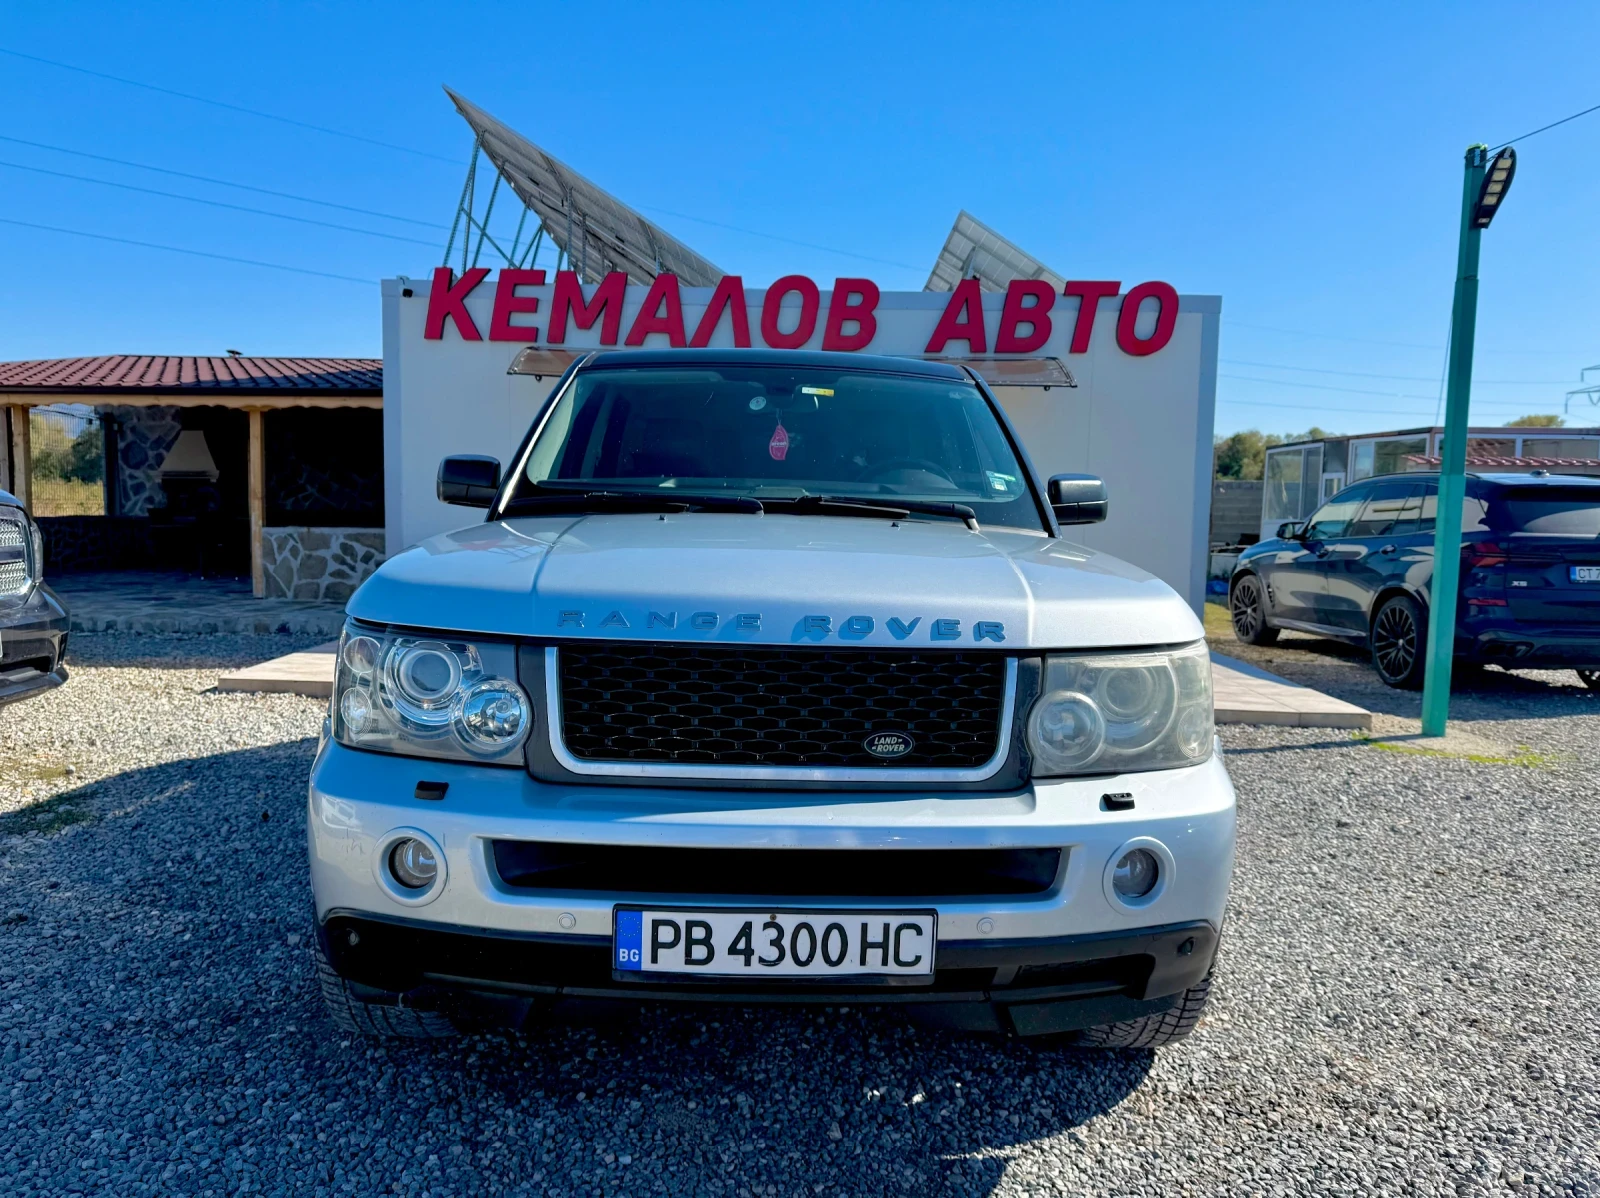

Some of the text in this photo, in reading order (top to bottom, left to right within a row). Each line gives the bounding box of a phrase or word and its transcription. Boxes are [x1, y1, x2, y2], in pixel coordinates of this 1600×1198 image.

[424, 267, 1180, 357] КЕМАЛОВ АВТО
[556, 610, 1007, 642] RANGE ROVER
[876, 744, 905, 752] ROVER
[619, 918, 924, 968] BG PB 4300 HC
